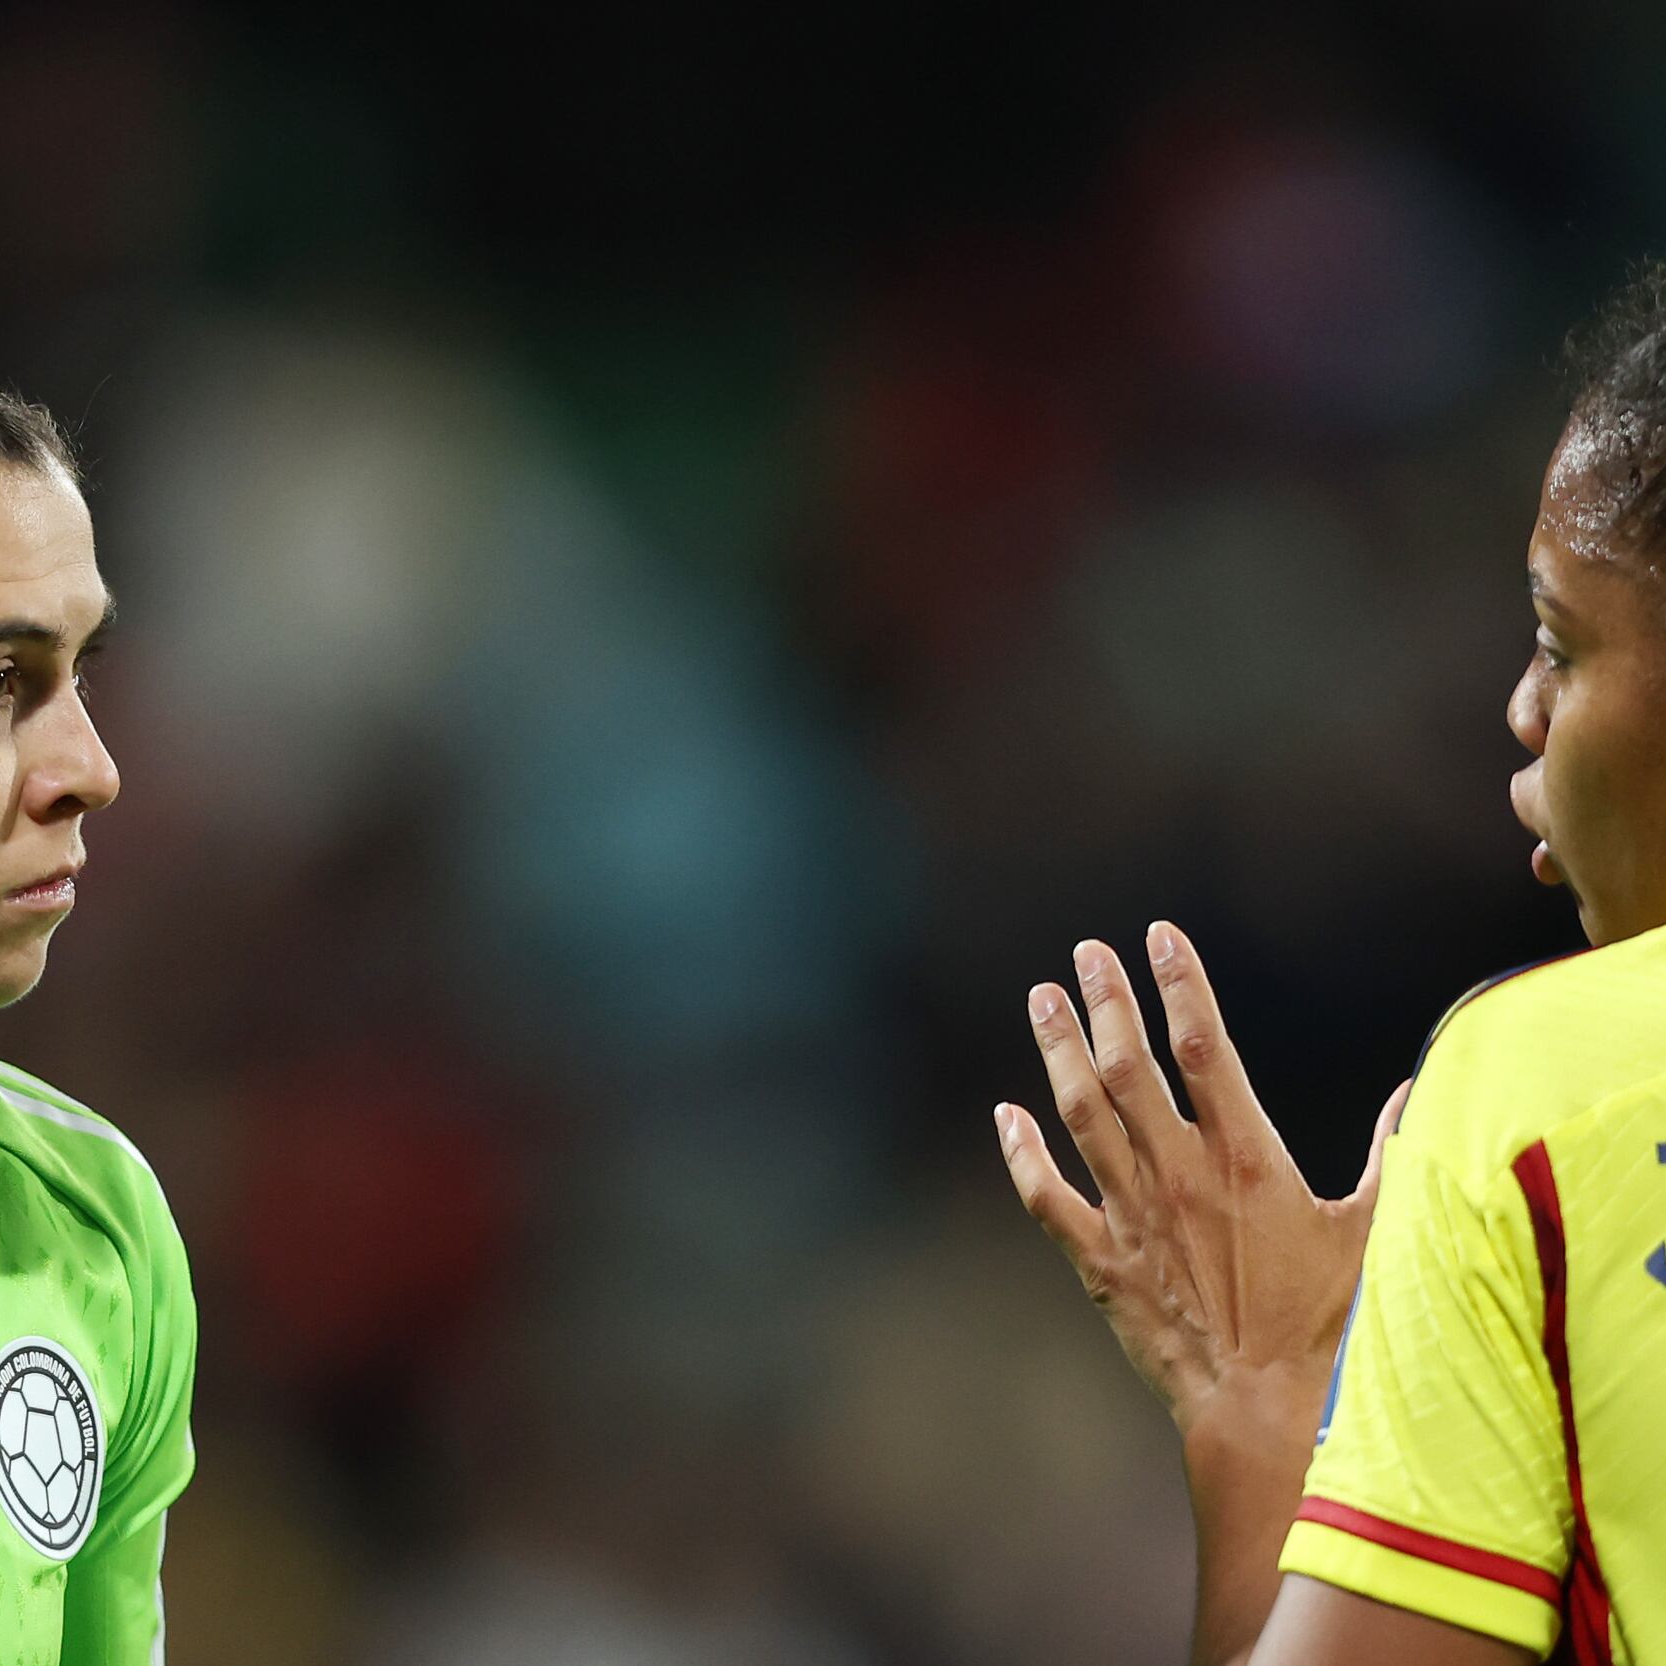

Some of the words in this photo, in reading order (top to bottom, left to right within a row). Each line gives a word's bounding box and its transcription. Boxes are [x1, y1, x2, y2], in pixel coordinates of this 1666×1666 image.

[13, 1351, 71, 1387] COLOMBIANA
[68, 1380, 83, 1403] DE
[76, 1399, 95, 1457] FUTBOL
